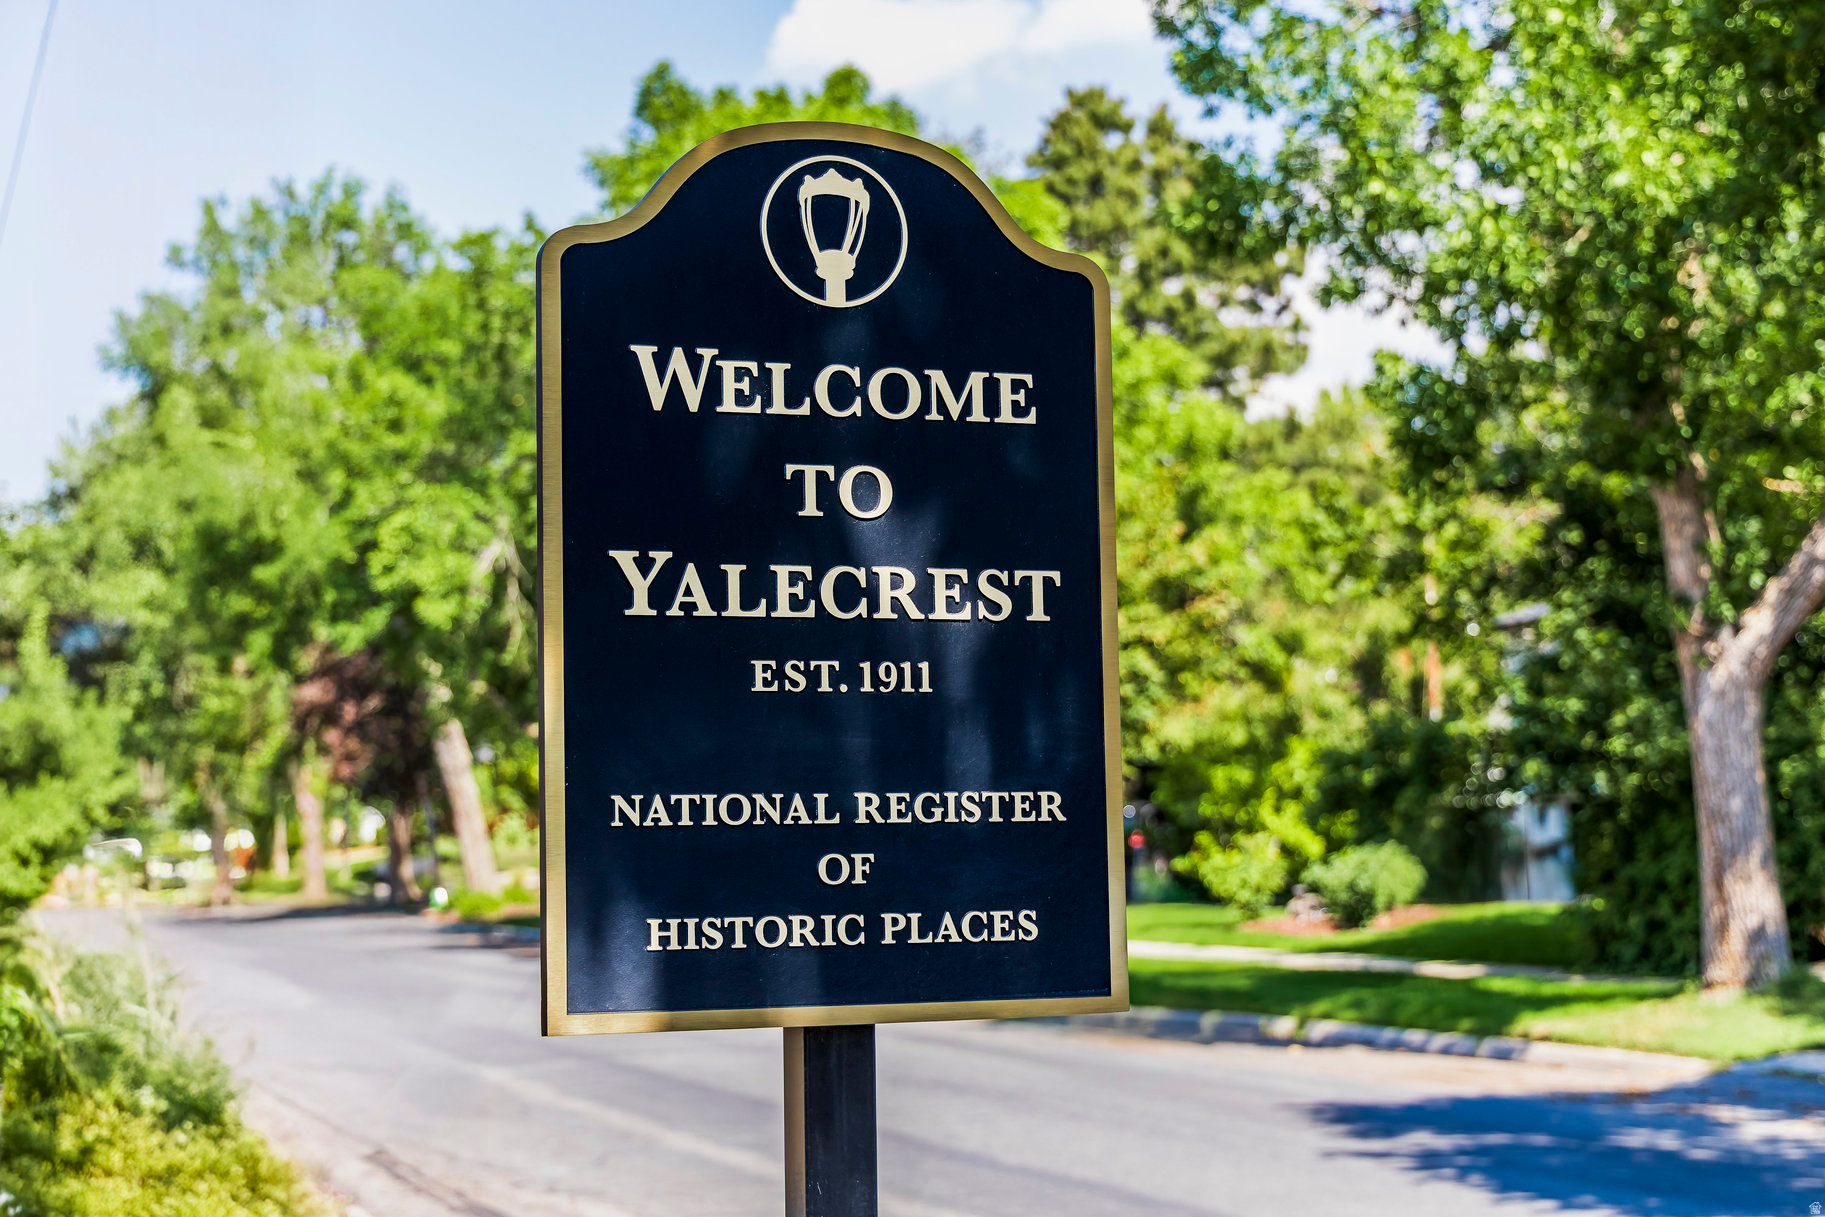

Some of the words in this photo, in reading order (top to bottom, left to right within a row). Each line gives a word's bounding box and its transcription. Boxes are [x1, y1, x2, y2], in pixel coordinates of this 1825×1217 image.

[630, 345, 1037, 425] WELCOME
[785, 464, 893, 519] TO
[609, 550, 1061, 622] YALECREST
[751, 660, 848, 693] EST.
[860, 661, 933, 693] 1911
[611, 793, 840, 827] NATIONAL
[854, 791, 1067, 824] REGISTER
[818, 853, 875, 885] OF
[645, 914, 865, 951] HISTORIC
[881, 910, 1039, 945] PLACES
